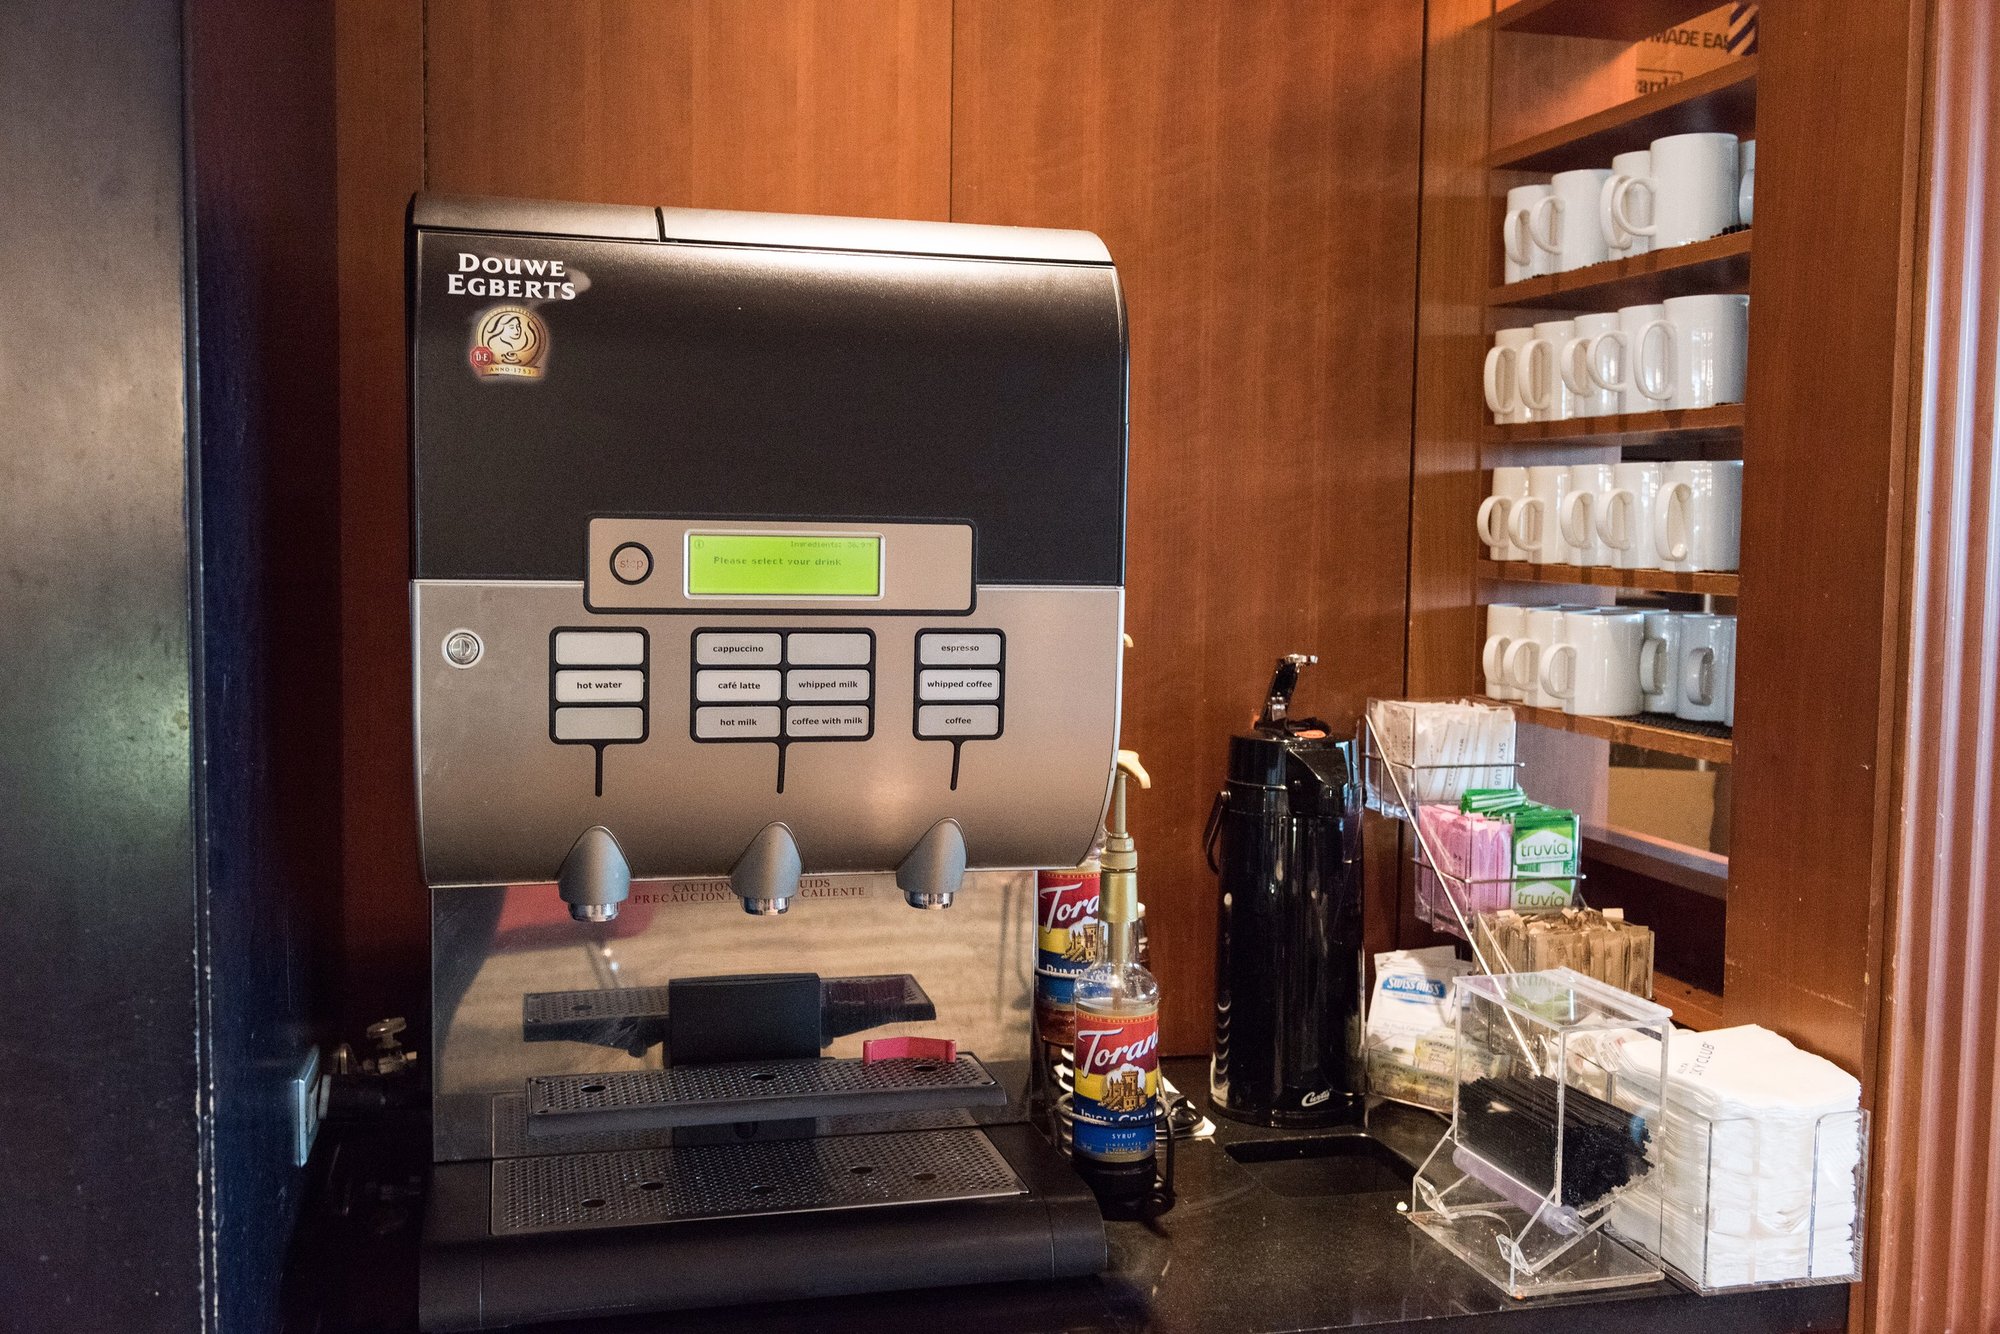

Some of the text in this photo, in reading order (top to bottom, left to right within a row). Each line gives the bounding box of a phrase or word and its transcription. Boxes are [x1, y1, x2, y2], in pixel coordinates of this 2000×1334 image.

[458, 252, 566, 277] DOUWE
[447, 273, 576, 301] EGBERTS
[713, 555, 747, 565] Please
[752, 556, 783, 565] select
[787, 558, 810, 567] your
[713, 645, 764, 654] cappuccino
[941, 645, 980, 653] espresso
[576, 681, 622, 689] hot water
[718, 681, 761, 690] café latte
[798, 680, 858, 690] whipped milk
[927, 680, 993, 689] whipped coffee
[720, 718, 757, 726] hot milk
[791, 716, 863, 725] coffee with milk
[945, 716, 972, 725] coffee
[801, 887, 865, 898] CALIENTE
[1040, 881, 1099, 934] Tora
[1112, 1132, 1137, 1140] SYRUP
